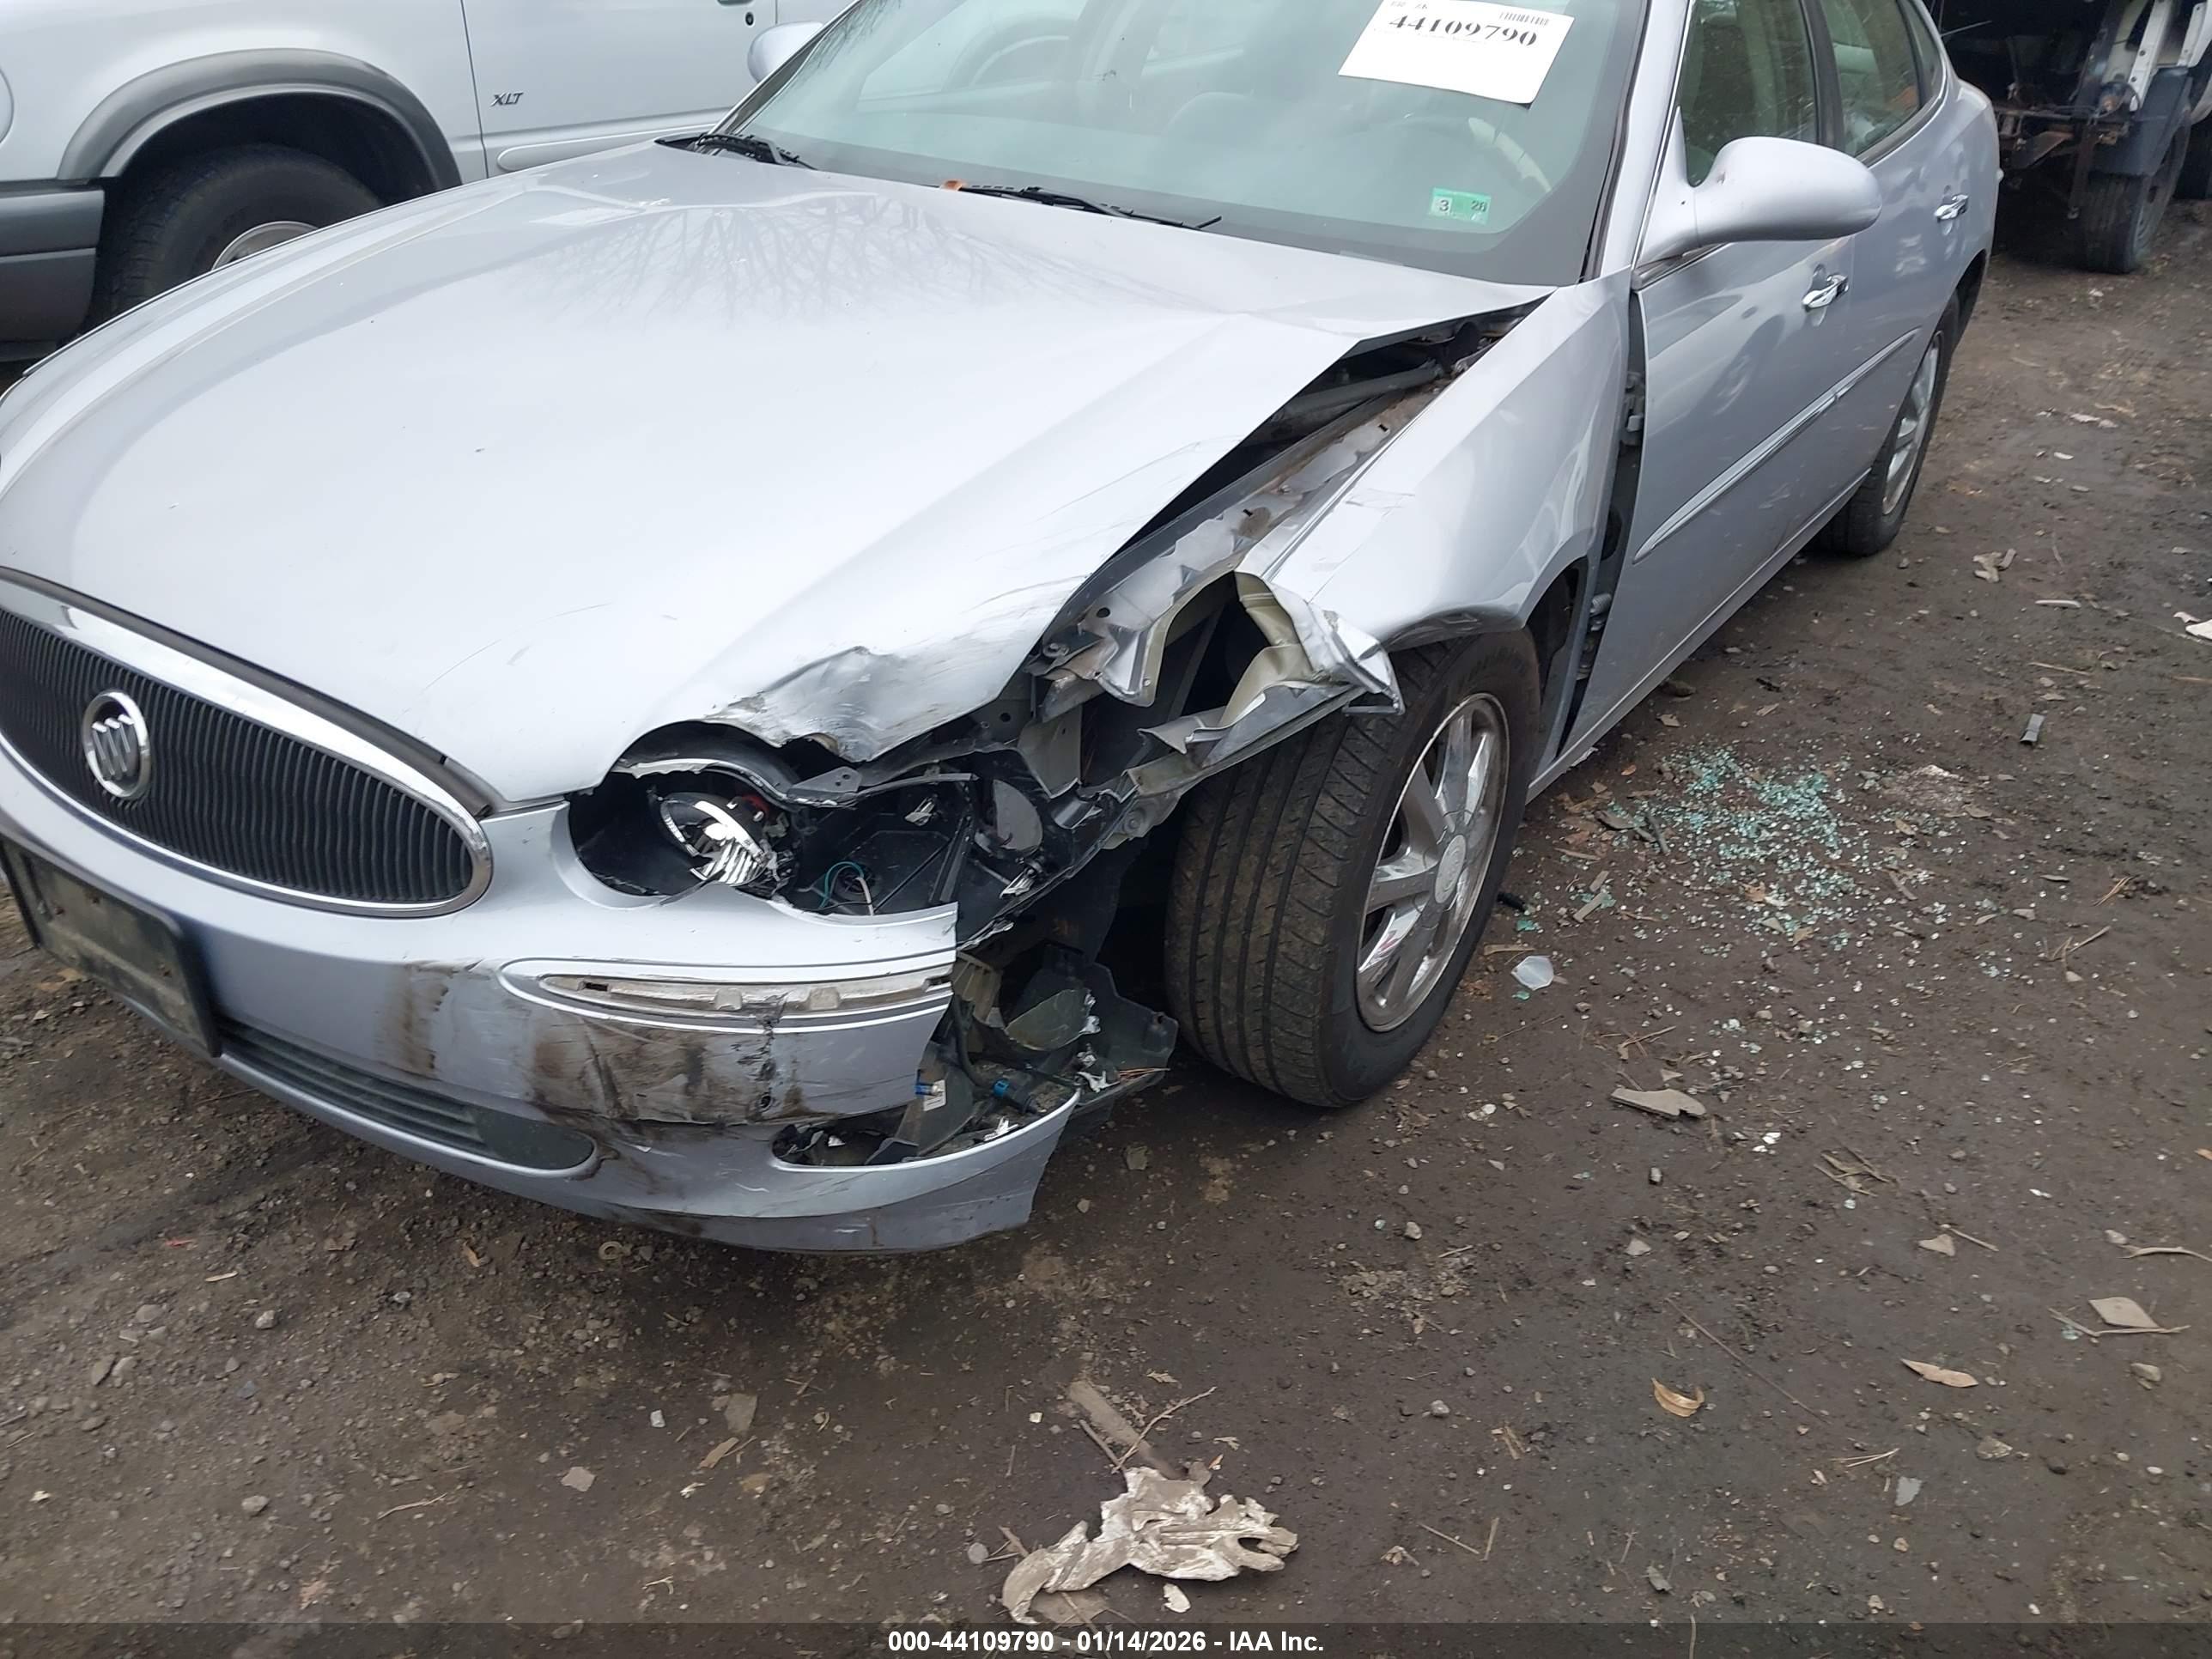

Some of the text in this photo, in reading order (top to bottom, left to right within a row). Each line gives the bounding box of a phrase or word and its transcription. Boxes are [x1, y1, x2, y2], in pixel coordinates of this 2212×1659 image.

[1389, 15, 1537, 46] 44109790
[490, 92, 523, 106] XLT
[1439, 199, 1449, 212] 3
